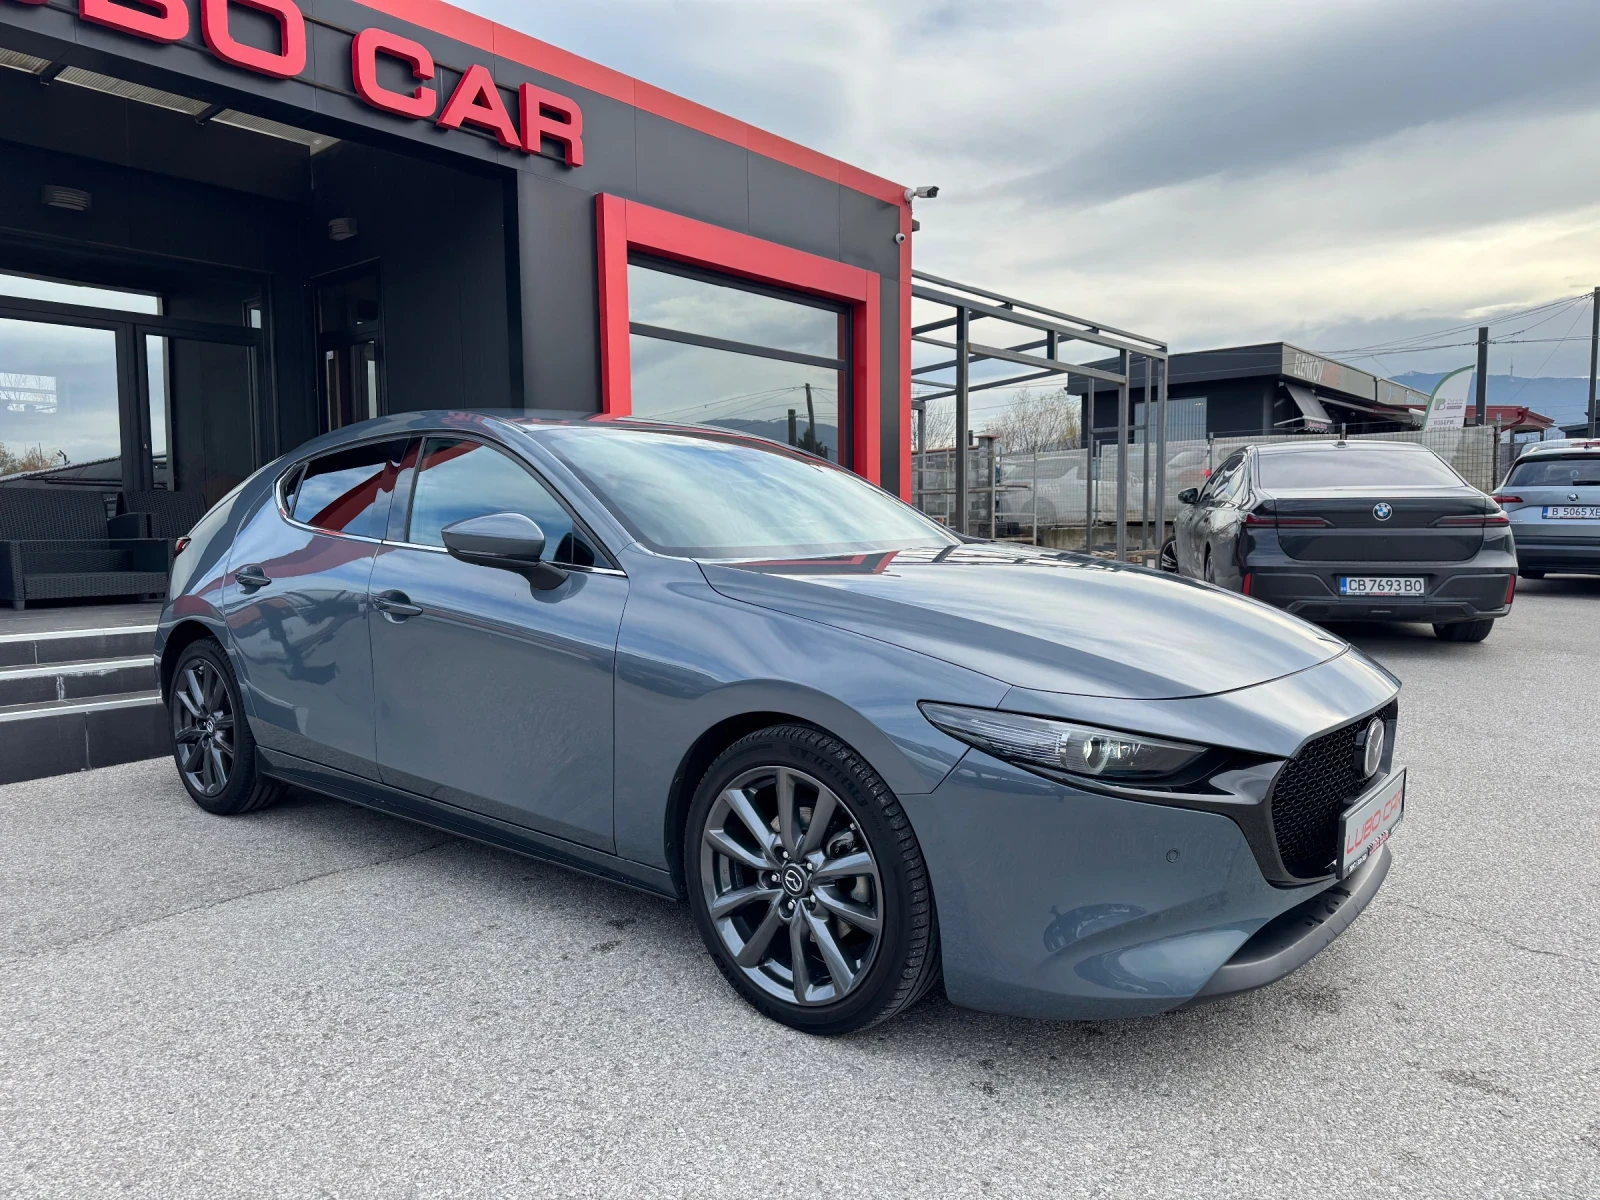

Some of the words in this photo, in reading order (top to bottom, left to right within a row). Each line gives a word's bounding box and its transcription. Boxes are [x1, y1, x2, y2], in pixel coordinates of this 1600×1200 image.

[351, 27, 583, 168] CAR
[1294, 353, 1325, 382] ELENKOV
[1552, 507, 1559, 516] B
[1563, 507, 1587, 516] 5065
[1349, 579, 1367, 592] CB
[1369, 579, 1402, 592] 7693
[1404, 579, 1422, 592] BO
[1346, 809, 1381, 854] LUBO
[1383, 786, 1402, 821] CAR
